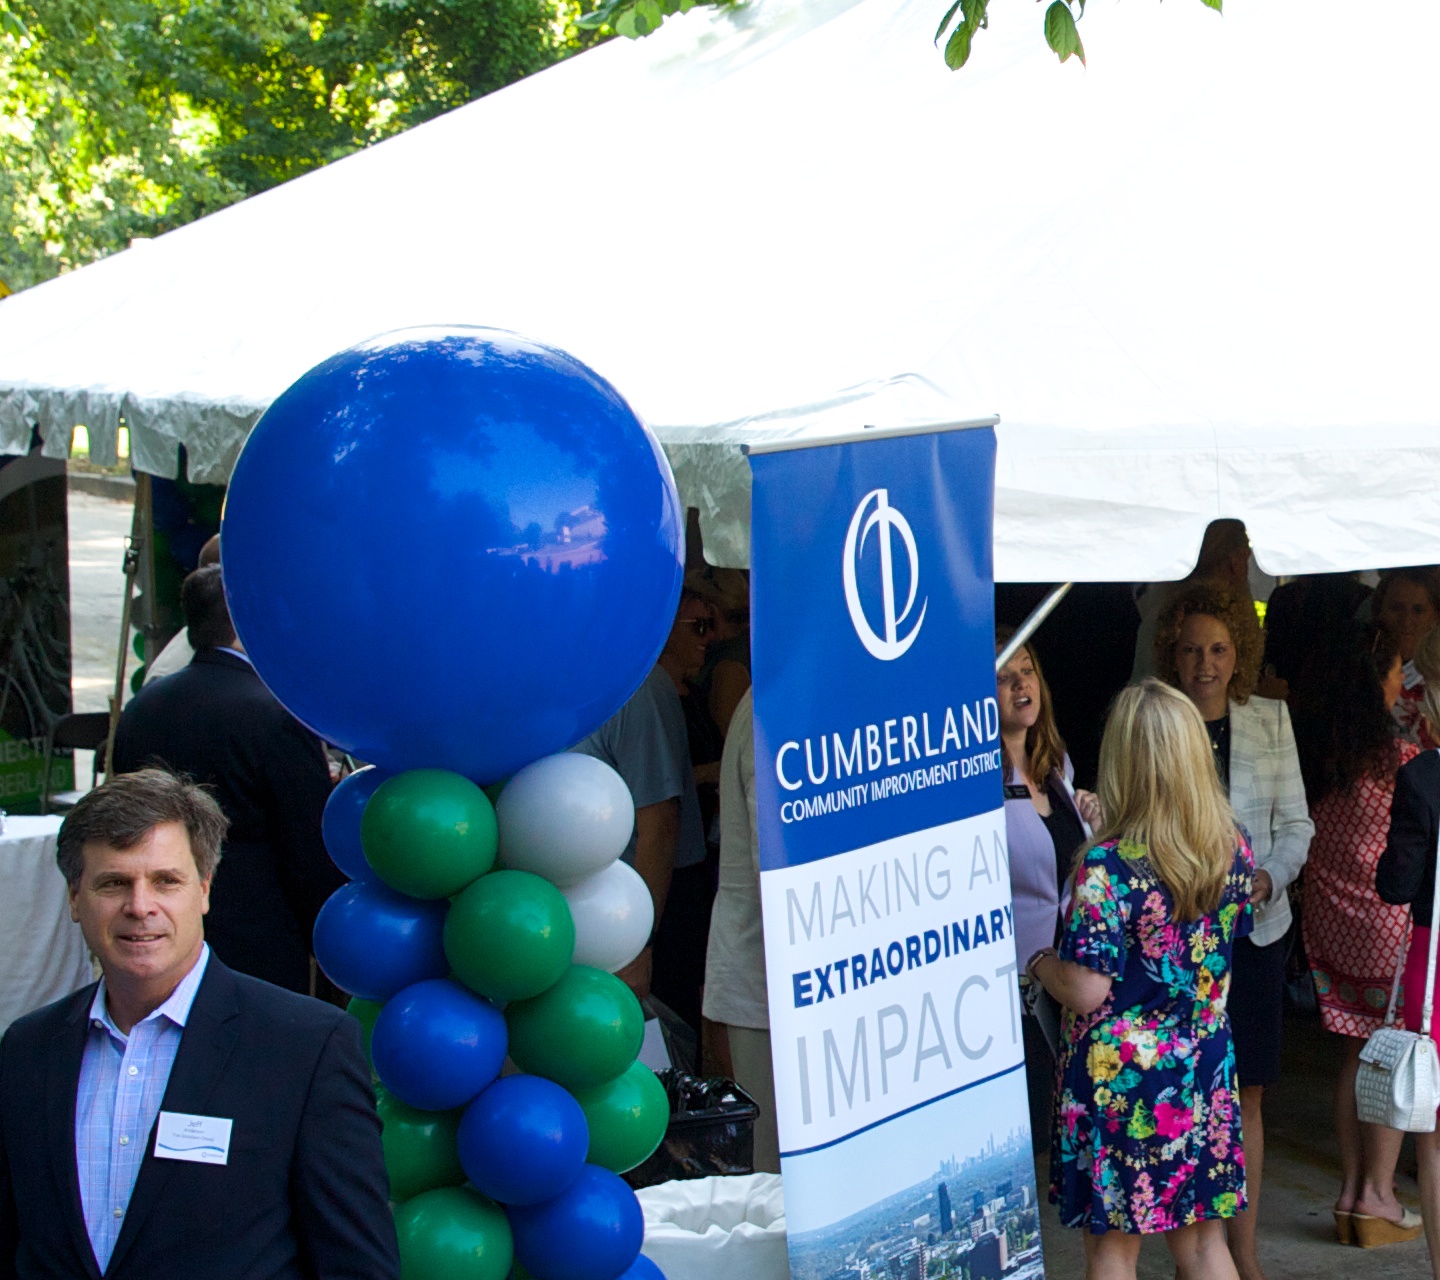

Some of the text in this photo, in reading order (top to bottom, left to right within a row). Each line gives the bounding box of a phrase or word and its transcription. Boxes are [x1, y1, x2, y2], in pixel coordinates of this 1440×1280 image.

[776, 697, 1000, 791] CUMBERLAND
[780, 748, 1002, 824] COMMUNITY IMPROVEMENT DISTRICT
[786, 845, 952, 946] MAKING
[792, 902, 1014, 1009] EXTRAORDINARY
[796, 959, 1018, 1126] IMPACT
